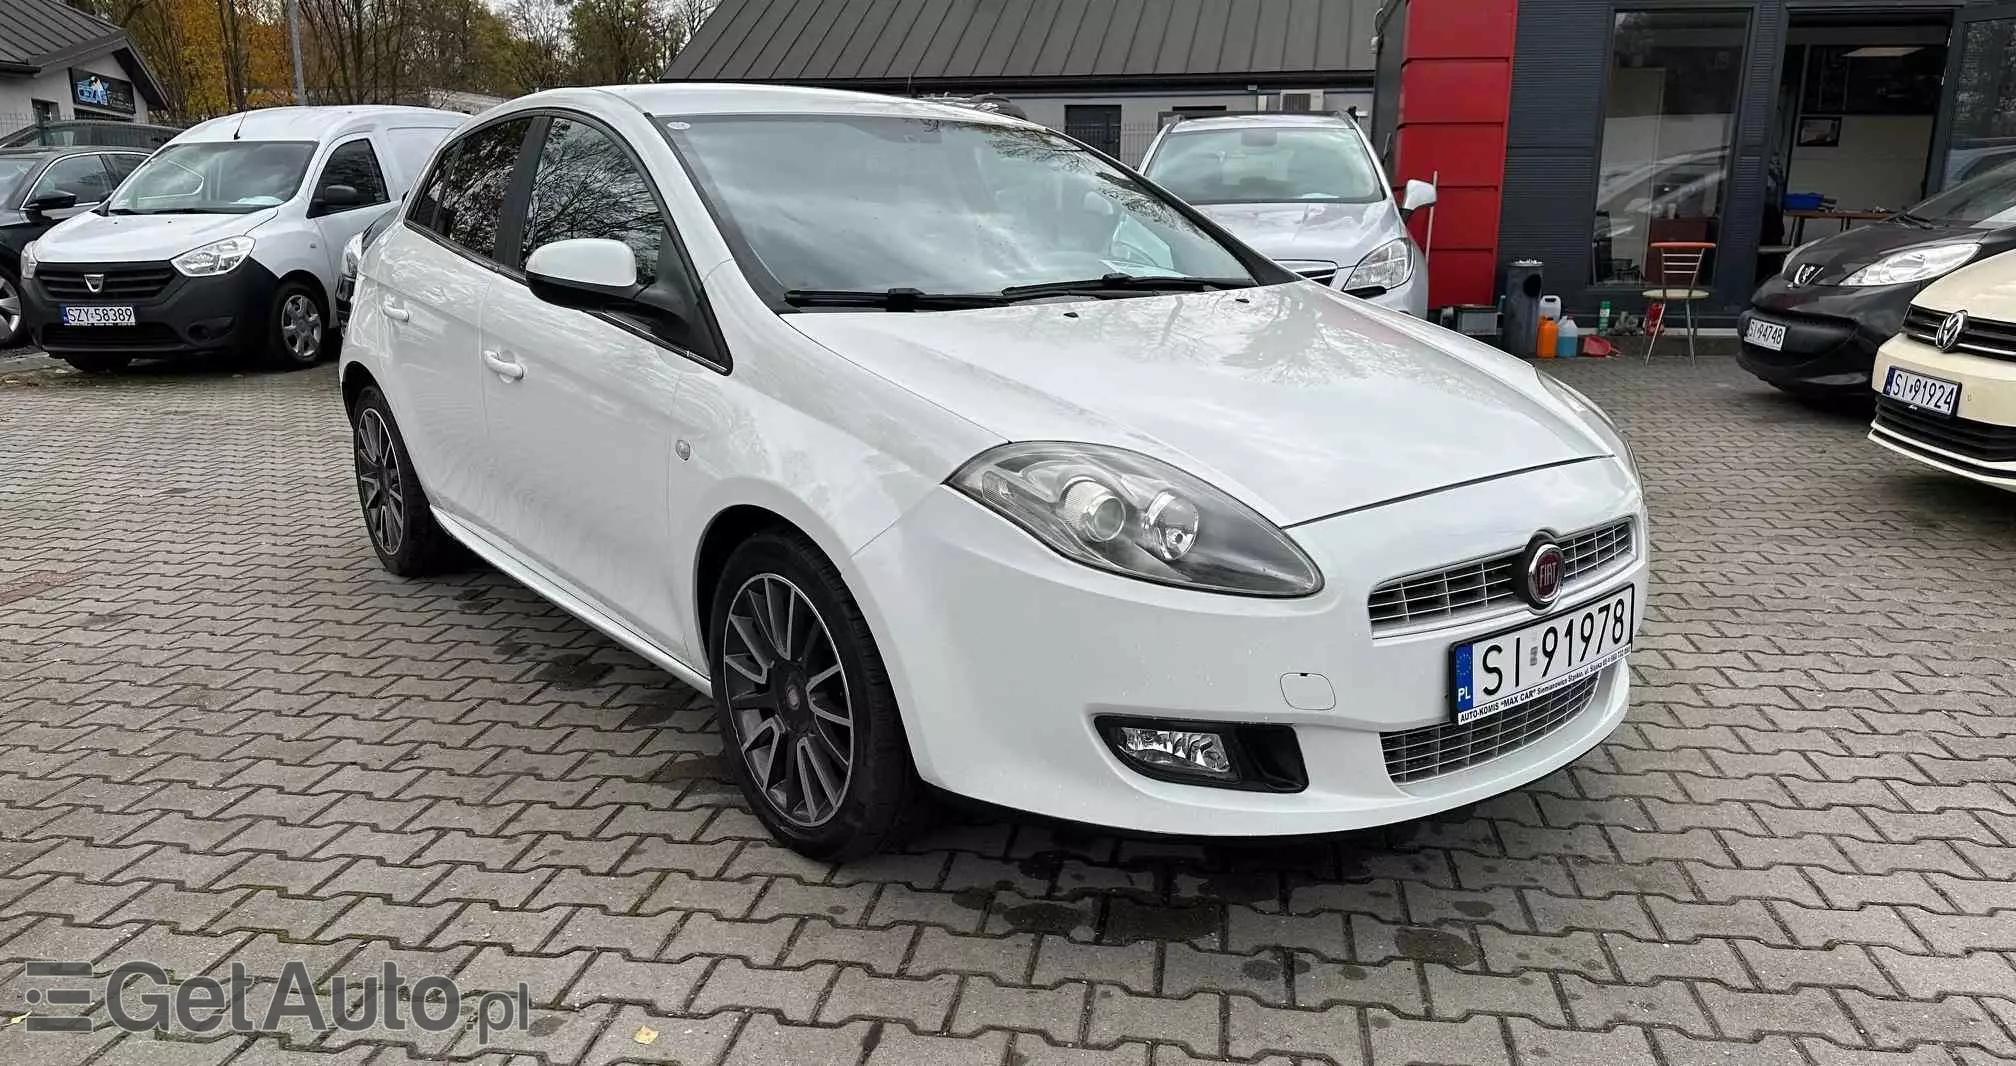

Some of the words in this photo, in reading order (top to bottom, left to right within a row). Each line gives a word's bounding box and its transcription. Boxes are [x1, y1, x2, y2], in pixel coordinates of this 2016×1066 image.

[67, 308, 89, 321] SZY
[94, 308, 133, 322] 58389
[1893, 373, 1909, 398] SI
[1912, 378, 1955, 411] 91924
[1539, 561, 1558, 588] FIAT
[1482, 637, 1521, 696] SI
[1541, 598, 1625, 678] 91978
[1457, 686, 1471, 702] PL
[1460, 702, 1500, 723] AUTO-KOMIS
